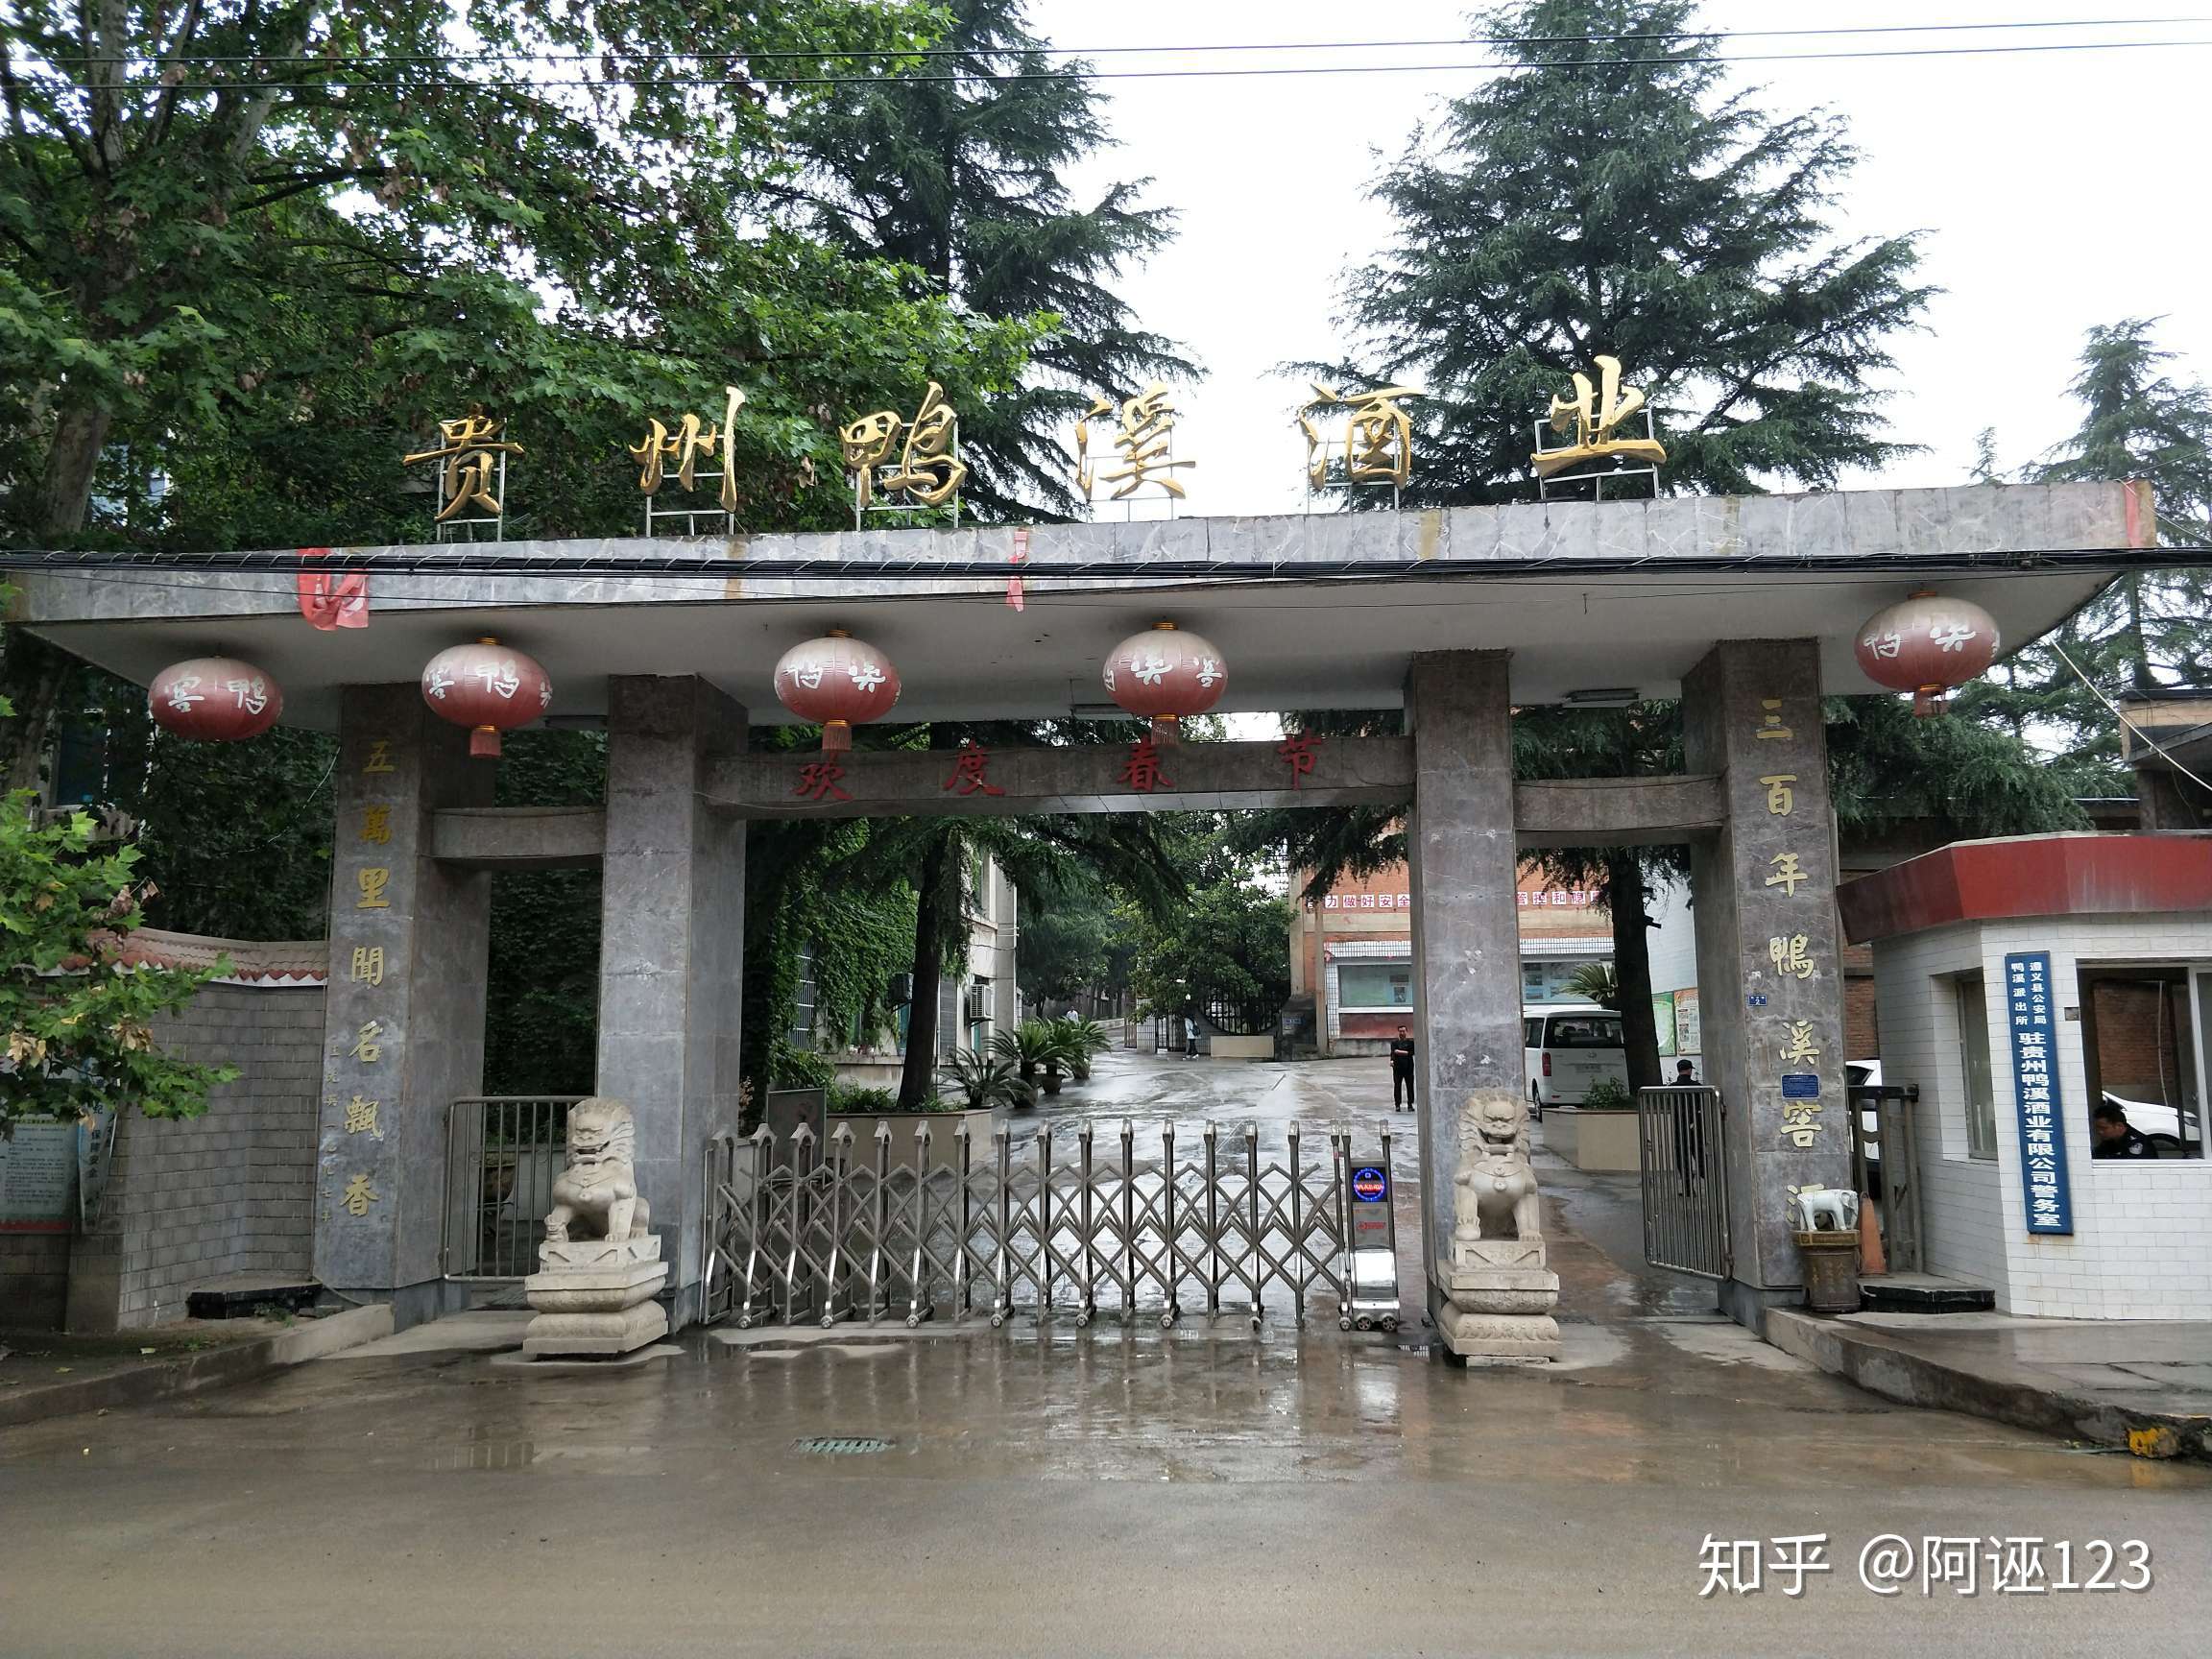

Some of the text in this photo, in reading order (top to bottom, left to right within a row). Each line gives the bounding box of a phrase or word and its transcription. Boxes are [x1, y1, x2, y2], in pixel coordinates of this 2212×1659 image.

[402, 353, 1668, 521] 贵州鸭溪酒业
[791, 730, 1326, 802] 欢度春节
[1307, 894, 1410, 908] 力做好安全
[2010, 962, 2029, 1025] 鸭溪派出所
[2029, 961, 2047, 1025] 遵义县公安局
[2017, 1032, 2062, 1227] 驻贵州鸭溪酒业有限公司警务室
